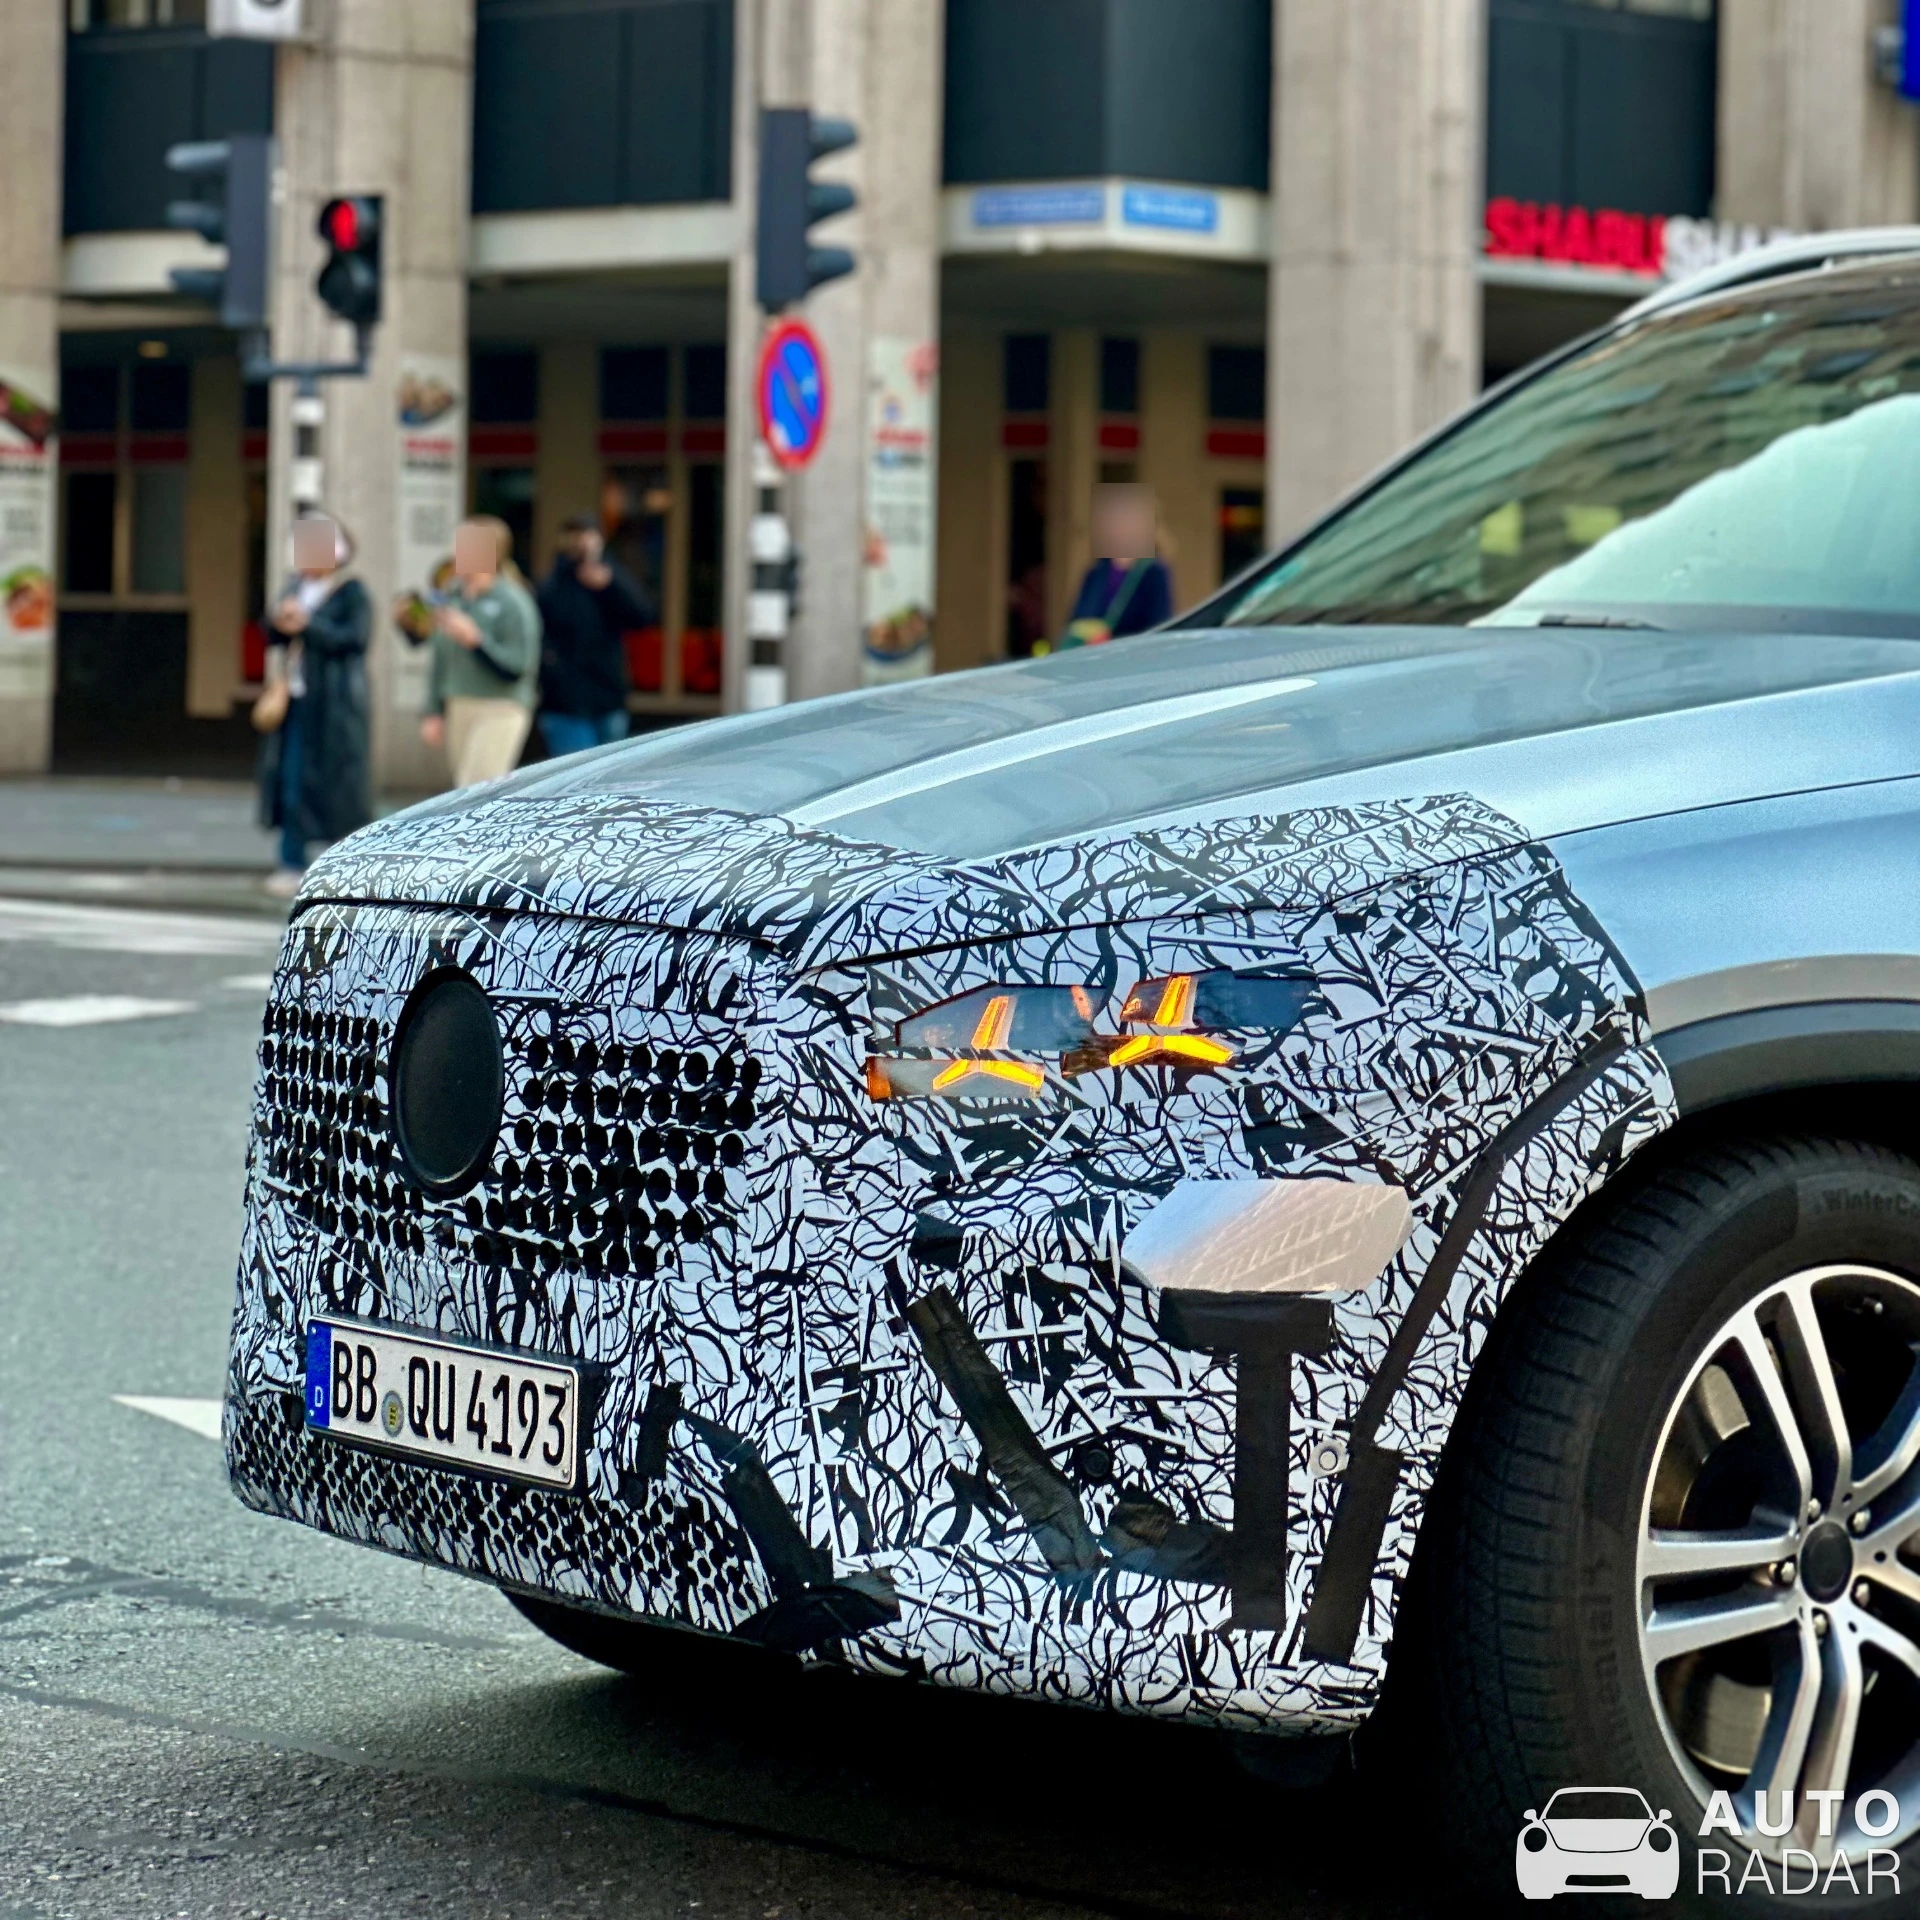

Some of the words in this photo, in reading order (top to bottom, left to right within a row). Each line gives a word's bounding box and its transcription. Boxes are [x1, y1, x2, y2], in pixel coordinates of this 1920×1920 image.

[315, 1386, 323, 1408] D
[333, 1340, 377, 1423] BB
[408, 1356, 456, 1444] QU
[466, 1368, 567, 1467] 4193
